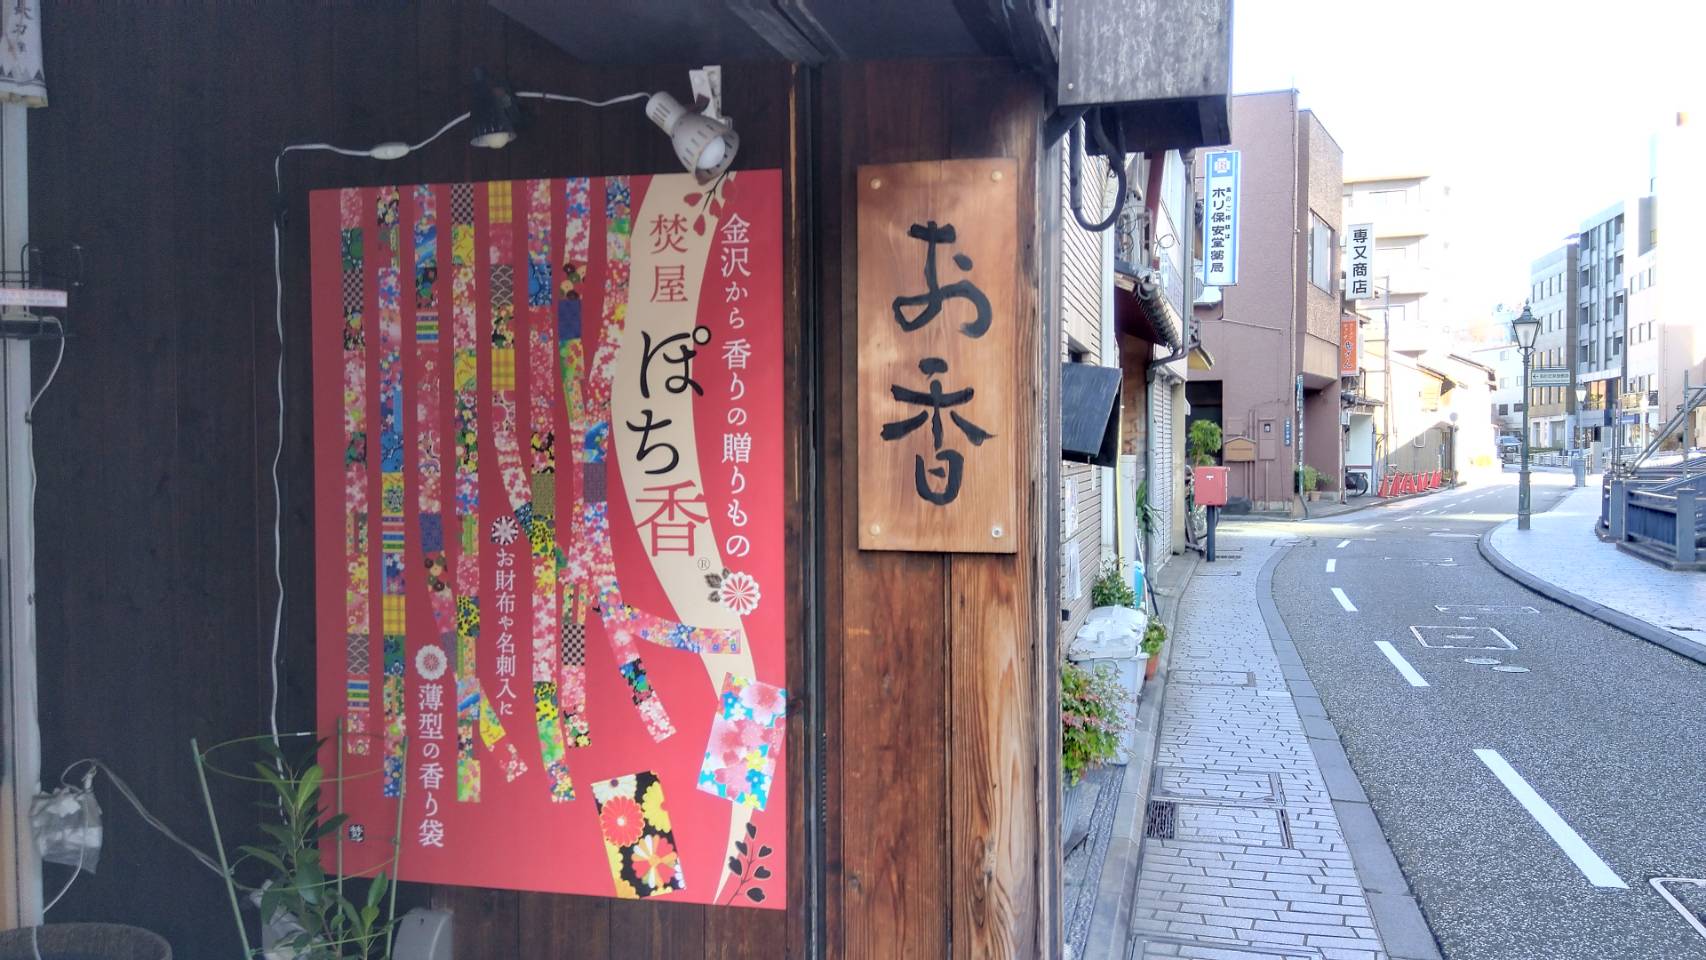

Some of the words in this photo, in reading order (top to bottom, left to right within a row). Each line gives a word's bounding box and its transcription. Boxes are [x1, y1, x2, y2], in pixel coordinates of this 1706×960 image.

[649, 213, 689, 303] 焚屋
[1210, 187, 1226, 273] ホリ保安堂薬局
[1352, 228, 1368, 295] 専又商店
[626, 325, 712, 557] ぽち香
[720, 212, 752, 557] 金沢から香りの贈りもの
[880, 220, 998, 506] お香
[494, 551, 517, 716] お財布や名刺入に
[418, 683, 445, 848] 薄型の香り袋
